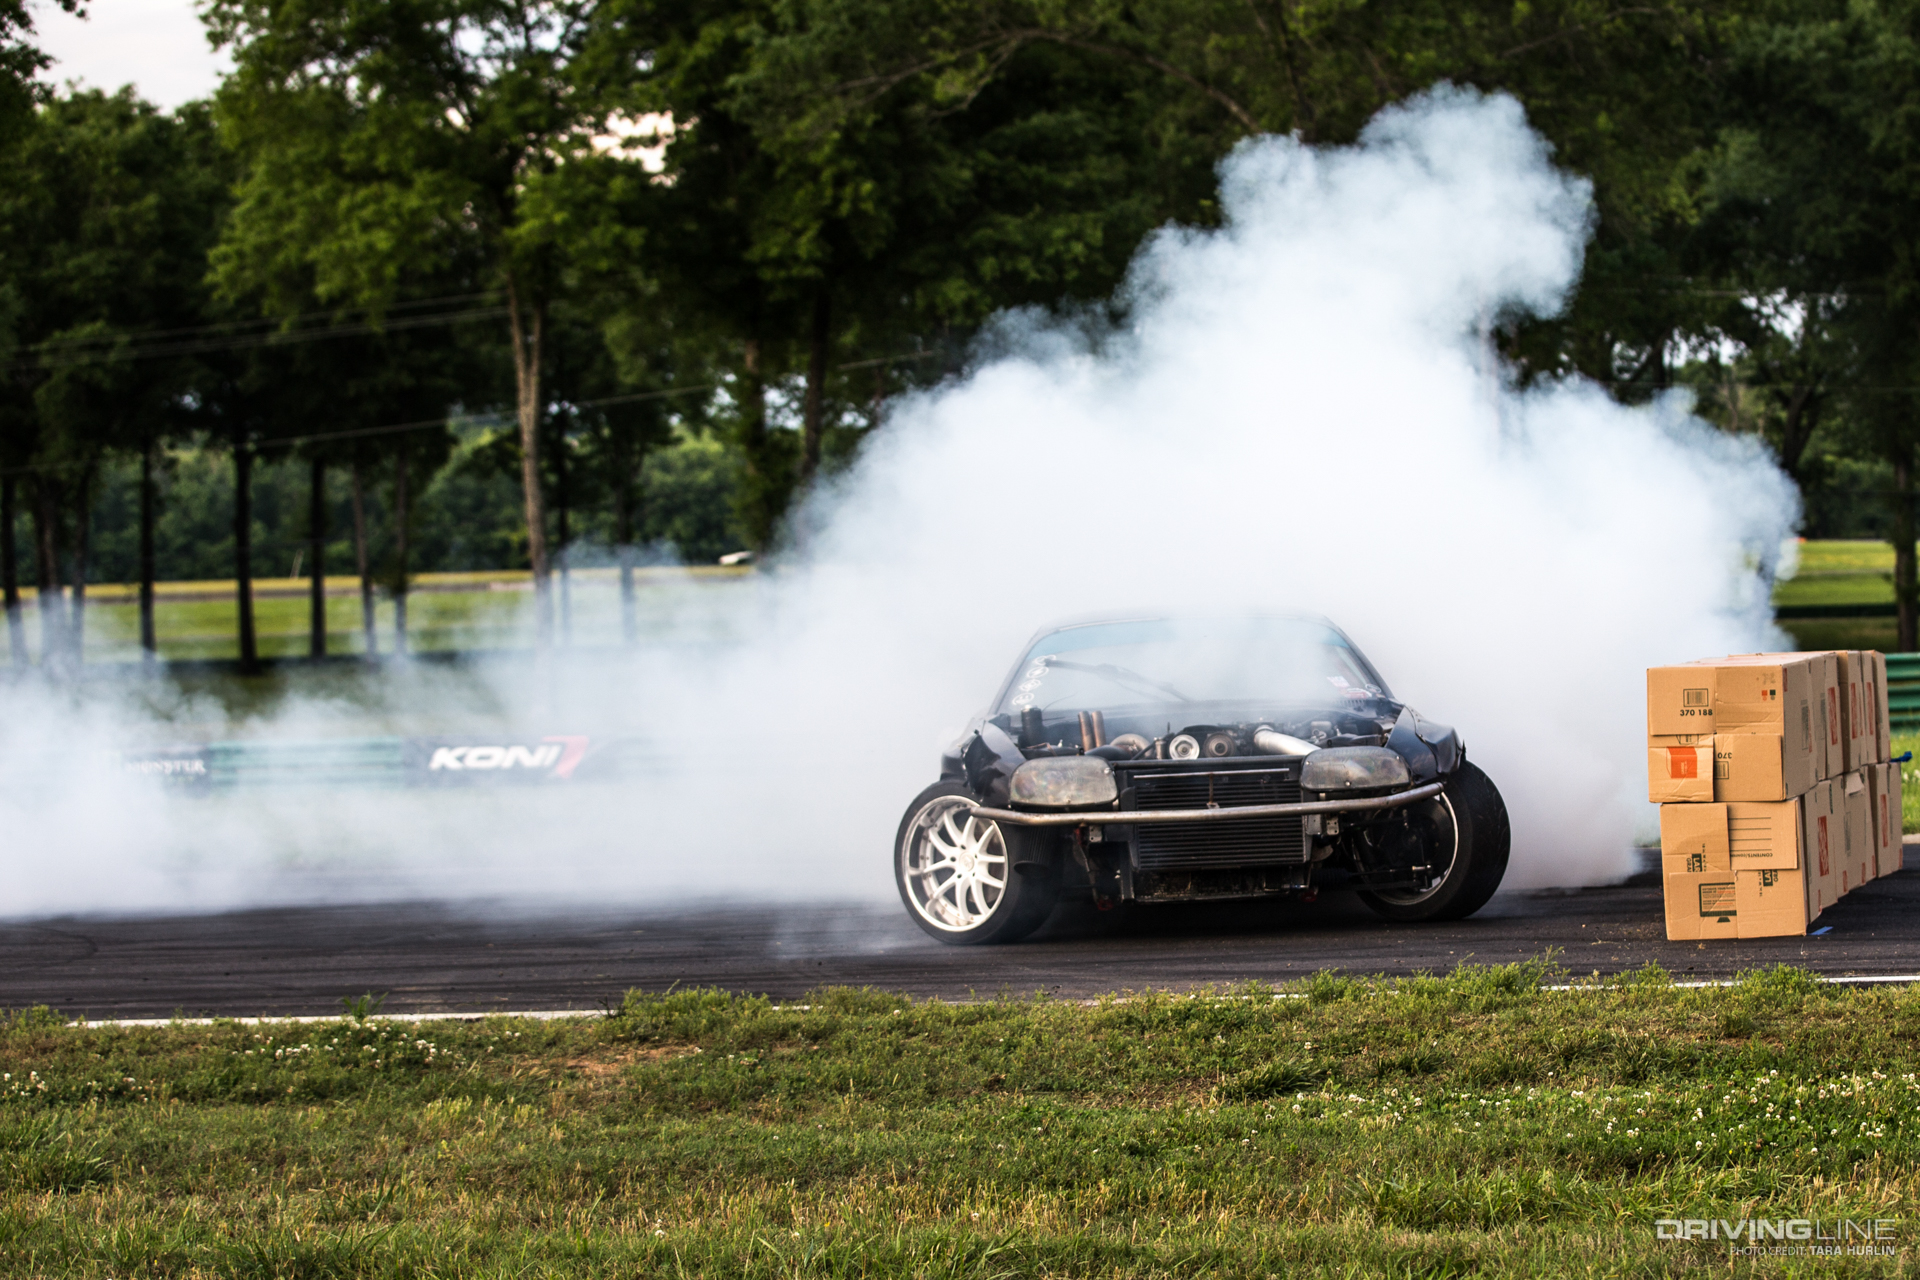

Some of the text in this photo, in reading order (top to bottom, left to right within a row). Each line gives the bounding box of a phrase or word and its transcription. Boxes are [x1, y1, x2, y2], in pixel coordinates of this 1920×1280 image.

[1680, 708, 1713, 717] 370 188
[428, 743, 561, 771] KONI
